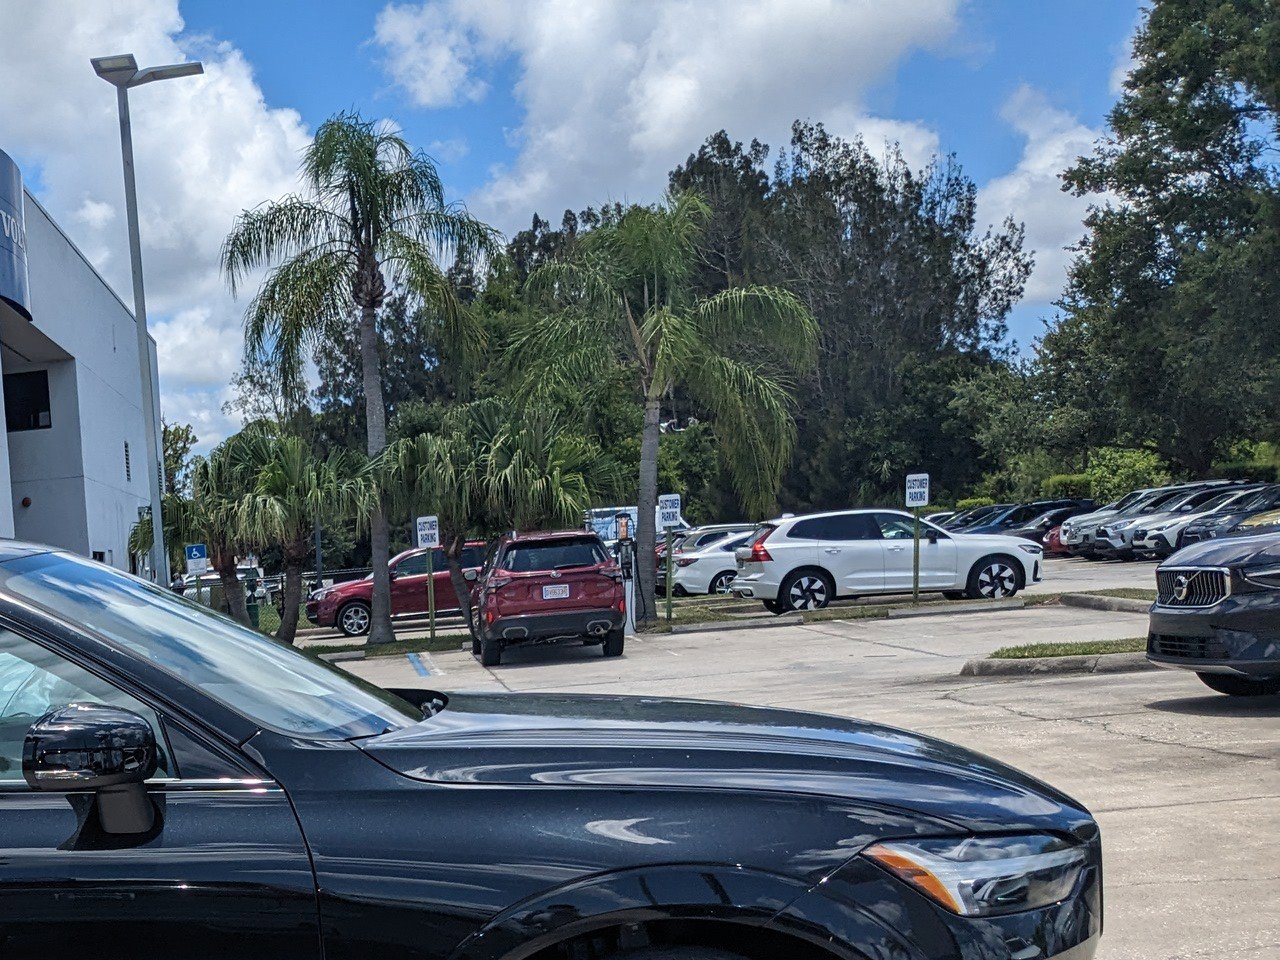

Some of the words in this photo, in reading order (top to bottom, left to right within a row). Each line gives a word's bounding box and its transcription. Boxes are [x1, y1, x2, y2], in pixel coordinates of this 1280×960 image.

[907, 478, 928, 489] CUSTOMER
[909, 491, 926, 501] PARKING
[660, 498, 679, 510] CUSTOMER
[662, 511, 677, 522] PARKING
[419, 520, 437, 532] CUSTOMER
[420, 533, 437, 543] PARKING
